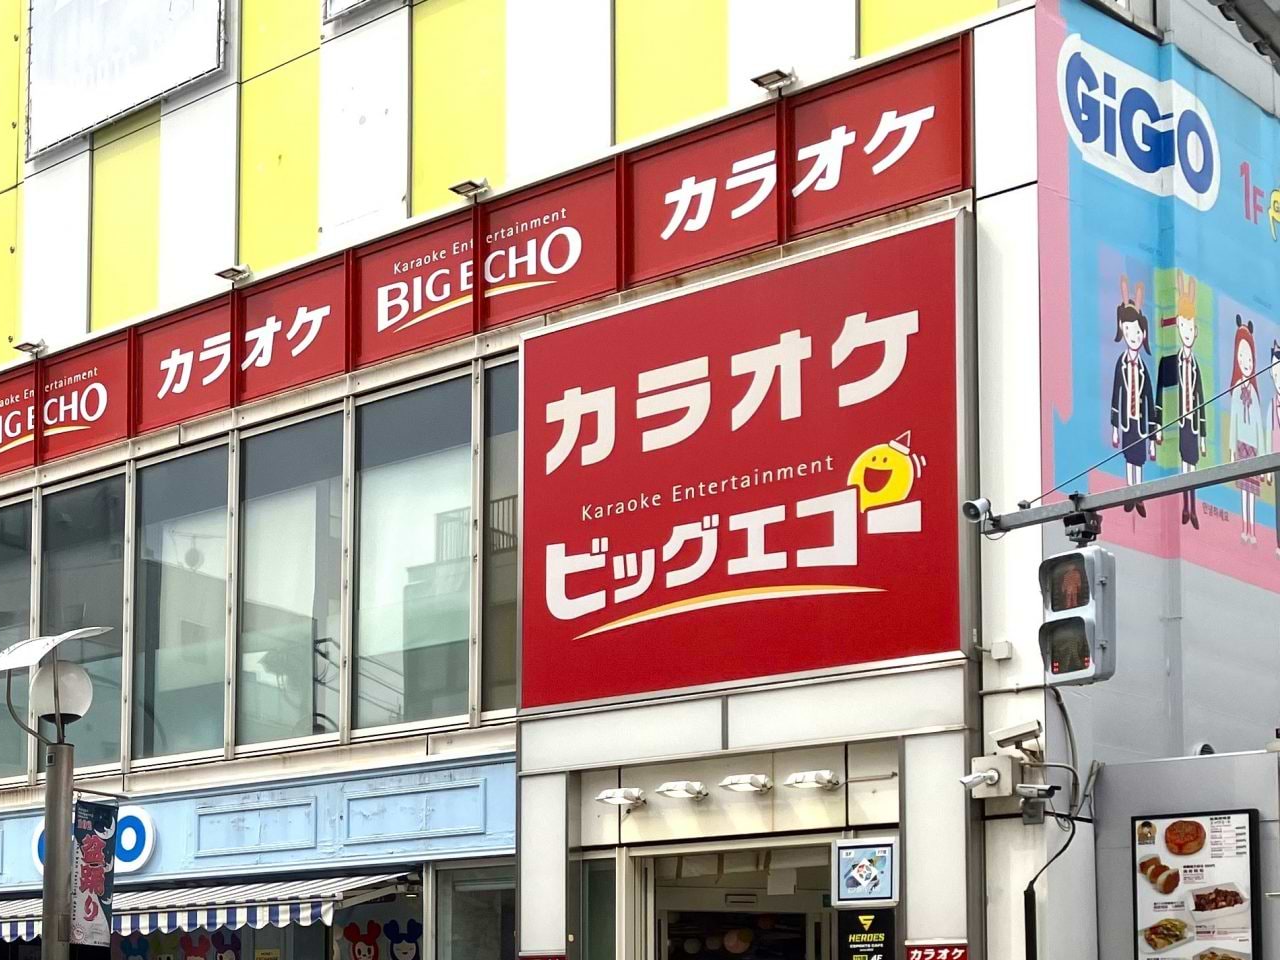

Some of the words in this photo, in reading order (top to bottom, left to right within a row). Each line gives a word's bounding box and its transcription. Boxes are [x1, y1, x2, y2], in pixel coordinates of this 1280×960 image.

[1066, 51, 1216, 194] GiGO
[660, 104, 935, 241] カラオケ
[377, 268, 451, 334] BIG
[460, 226, 583, 293] ECHO
[393, 248, 447, 275] Karaoke
[452, 206, 567, 256] Entertainment
[23, 366, 98, 400] Entertainment
[157, 305, 331, 400] カラオケ
[546, 309, 919, 476] カラオケ
[26, 382, 108, 430] ECHO
[582, 491, 662, 522] Karaoke
[672, 454, 835, 503] Entertainment
[546, 488, 922, 621] ビッグエコー
[848, 933, 885, 942] HEROES
[910, 948, 965, 960] カラオケ
